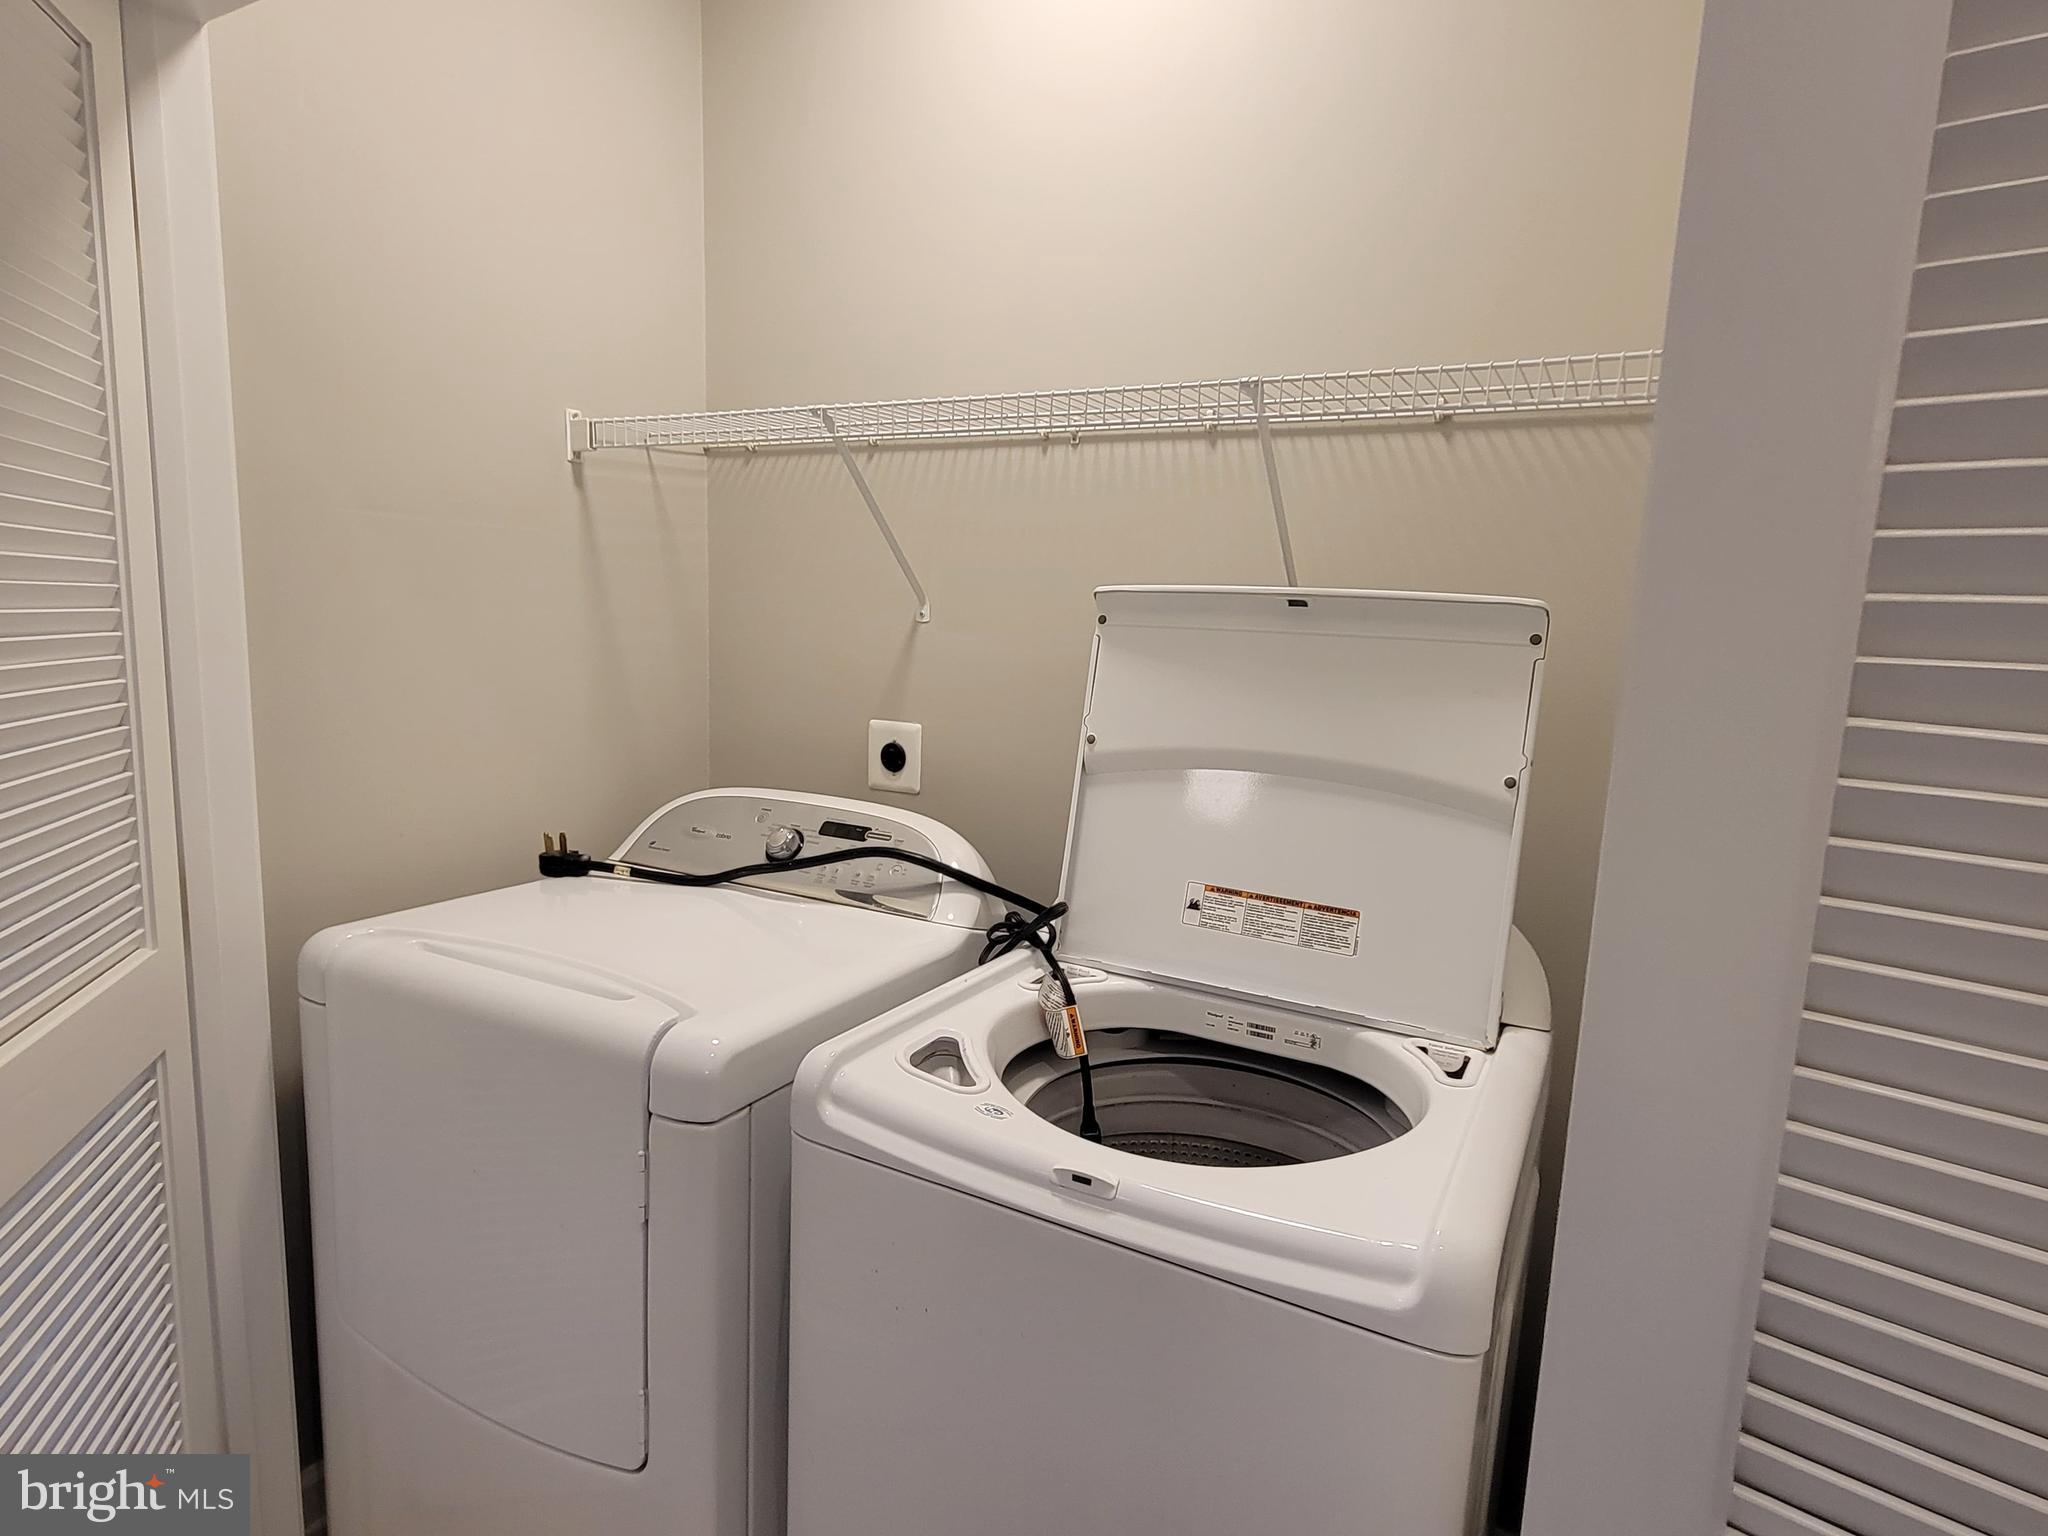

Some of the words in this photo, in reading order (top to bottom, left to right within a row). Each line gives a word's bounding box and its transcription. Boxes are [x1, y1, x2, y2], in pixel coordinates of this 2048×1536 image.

[1215, 886, 1243, 897] WARNING
[1254, 893, 1303, 908] AVERTISSEMENT
[1313, 904, 1358, 917] ADVERTENCIA
[1069, 1013, 1082, 1049] WARNING
